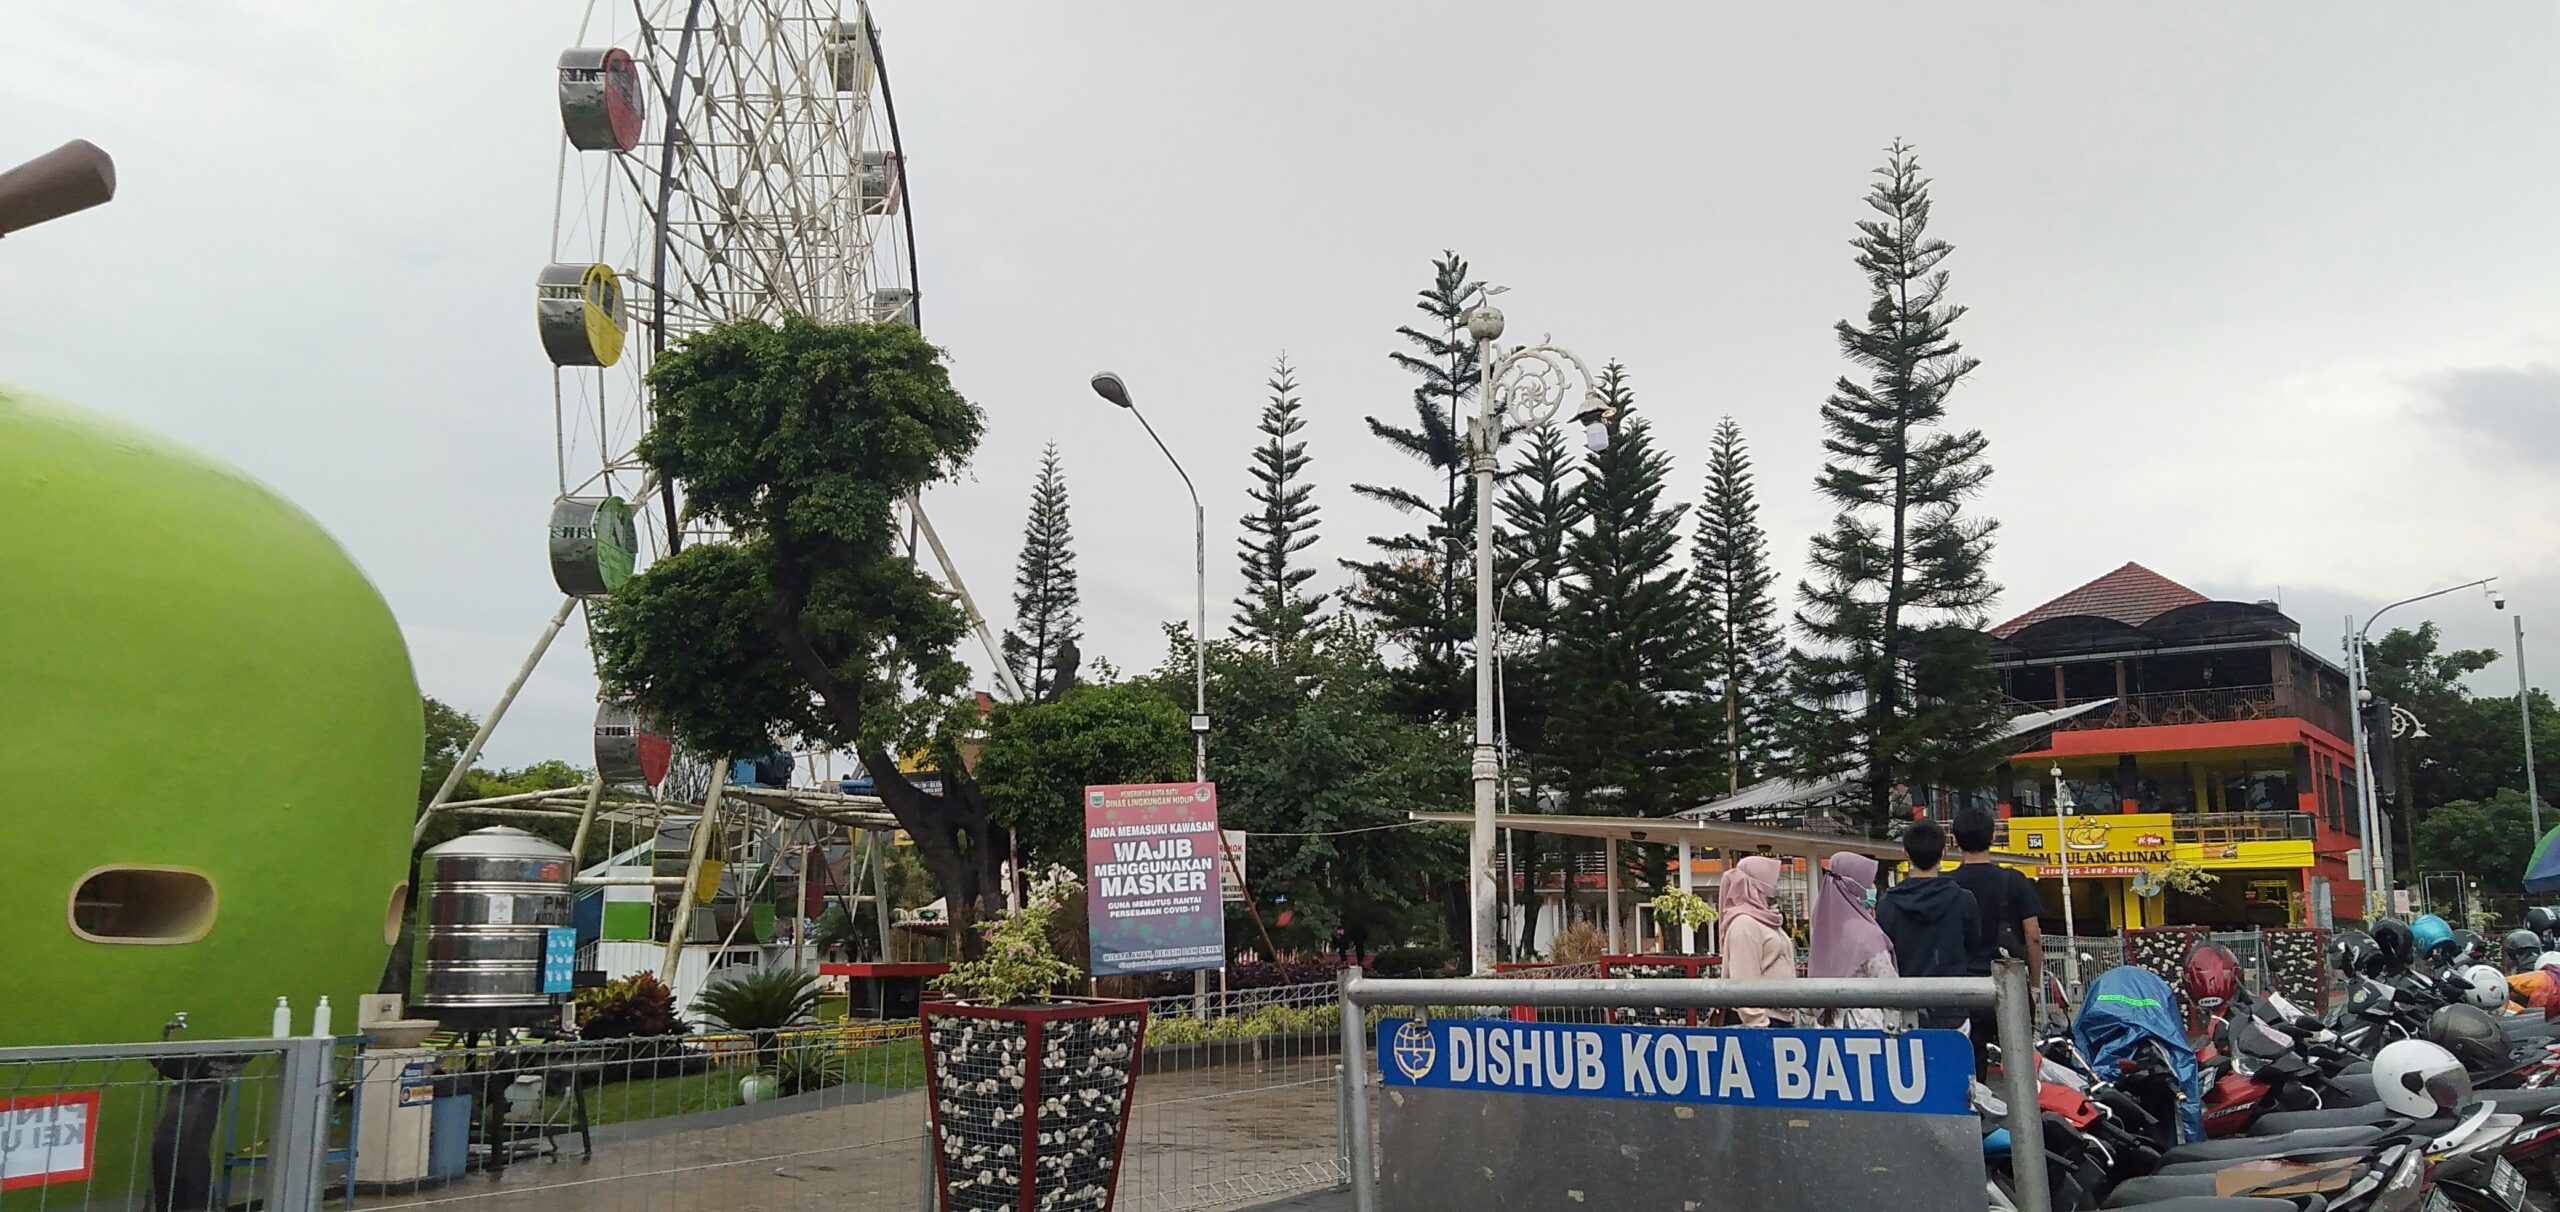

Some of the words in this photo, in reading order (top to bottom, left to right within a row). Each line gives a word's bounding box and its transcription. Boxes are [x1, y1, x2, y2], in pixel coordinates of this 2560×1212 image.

[1105, 799, 1126, 808] DINAS
[1127, 797, 1172, 807] LINGKUNGAN
[1172, 796, 1194, 804] HIDUP
[1090, 828, 1116, 838] ANDA
[1118, 824, 1168, 837] MEMASUKI
[1170, 821, 1215, 833] KAWASAN
[1113, 839, 1193, 862] WAJIB
[2056, 852, 2117, 864] TULANG
[2119, 850, 2171, 863] LUNAK
[1094, 858, 1213, 877] MENGGUNAKAN
[1101, 872, 1207, 897] MASKER
[1108, 901, 1131, 910] GUNA
[1132, 898, 1171, 908] MEMUTUS
[1173, 896, 1202, 905] RANTAI
[1109, 908, 1162, 918] PERSEBARAN
[1163, 905, 1200, 914] COVID-19
[1103, 953, 1130, 962] WISATA
[1155, 948, 1182, 958] BERSIH
[1198, 944, 1223, 954] SEHAT
[1448, 1025, 1606, 1090] DISHUB
[1621, 1033, 1757, 1099] KOTA
[1772, 1037, 1926, 1104] BATU
